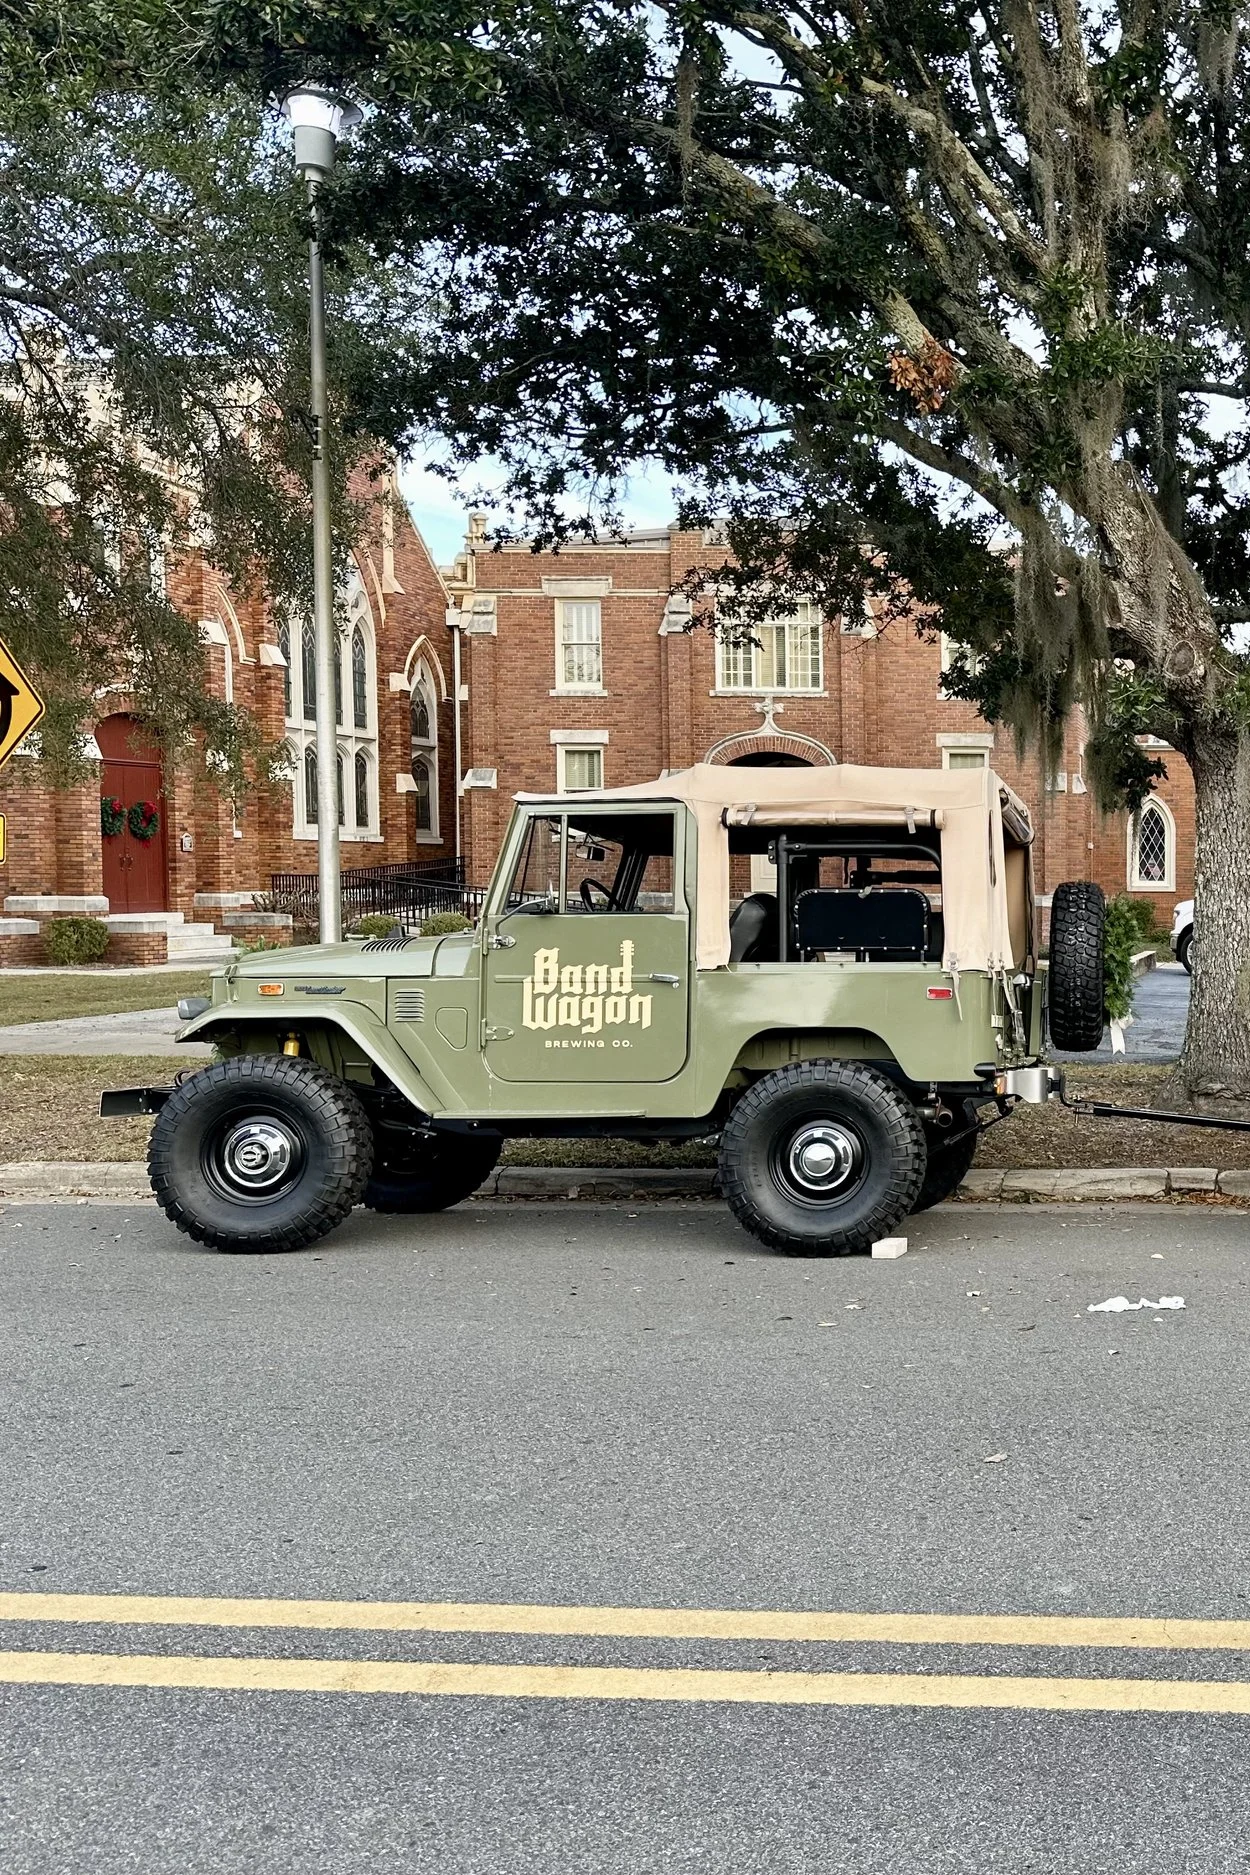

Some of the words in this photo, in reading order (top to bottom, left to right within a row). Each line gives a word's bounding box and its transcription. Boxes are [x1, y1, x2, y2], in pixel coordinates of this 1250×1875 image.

[533, 939, 635, 994] Band
[544, 1040, 605, 1048] BREWING
[612, 1039, 633, 1048] CO.
